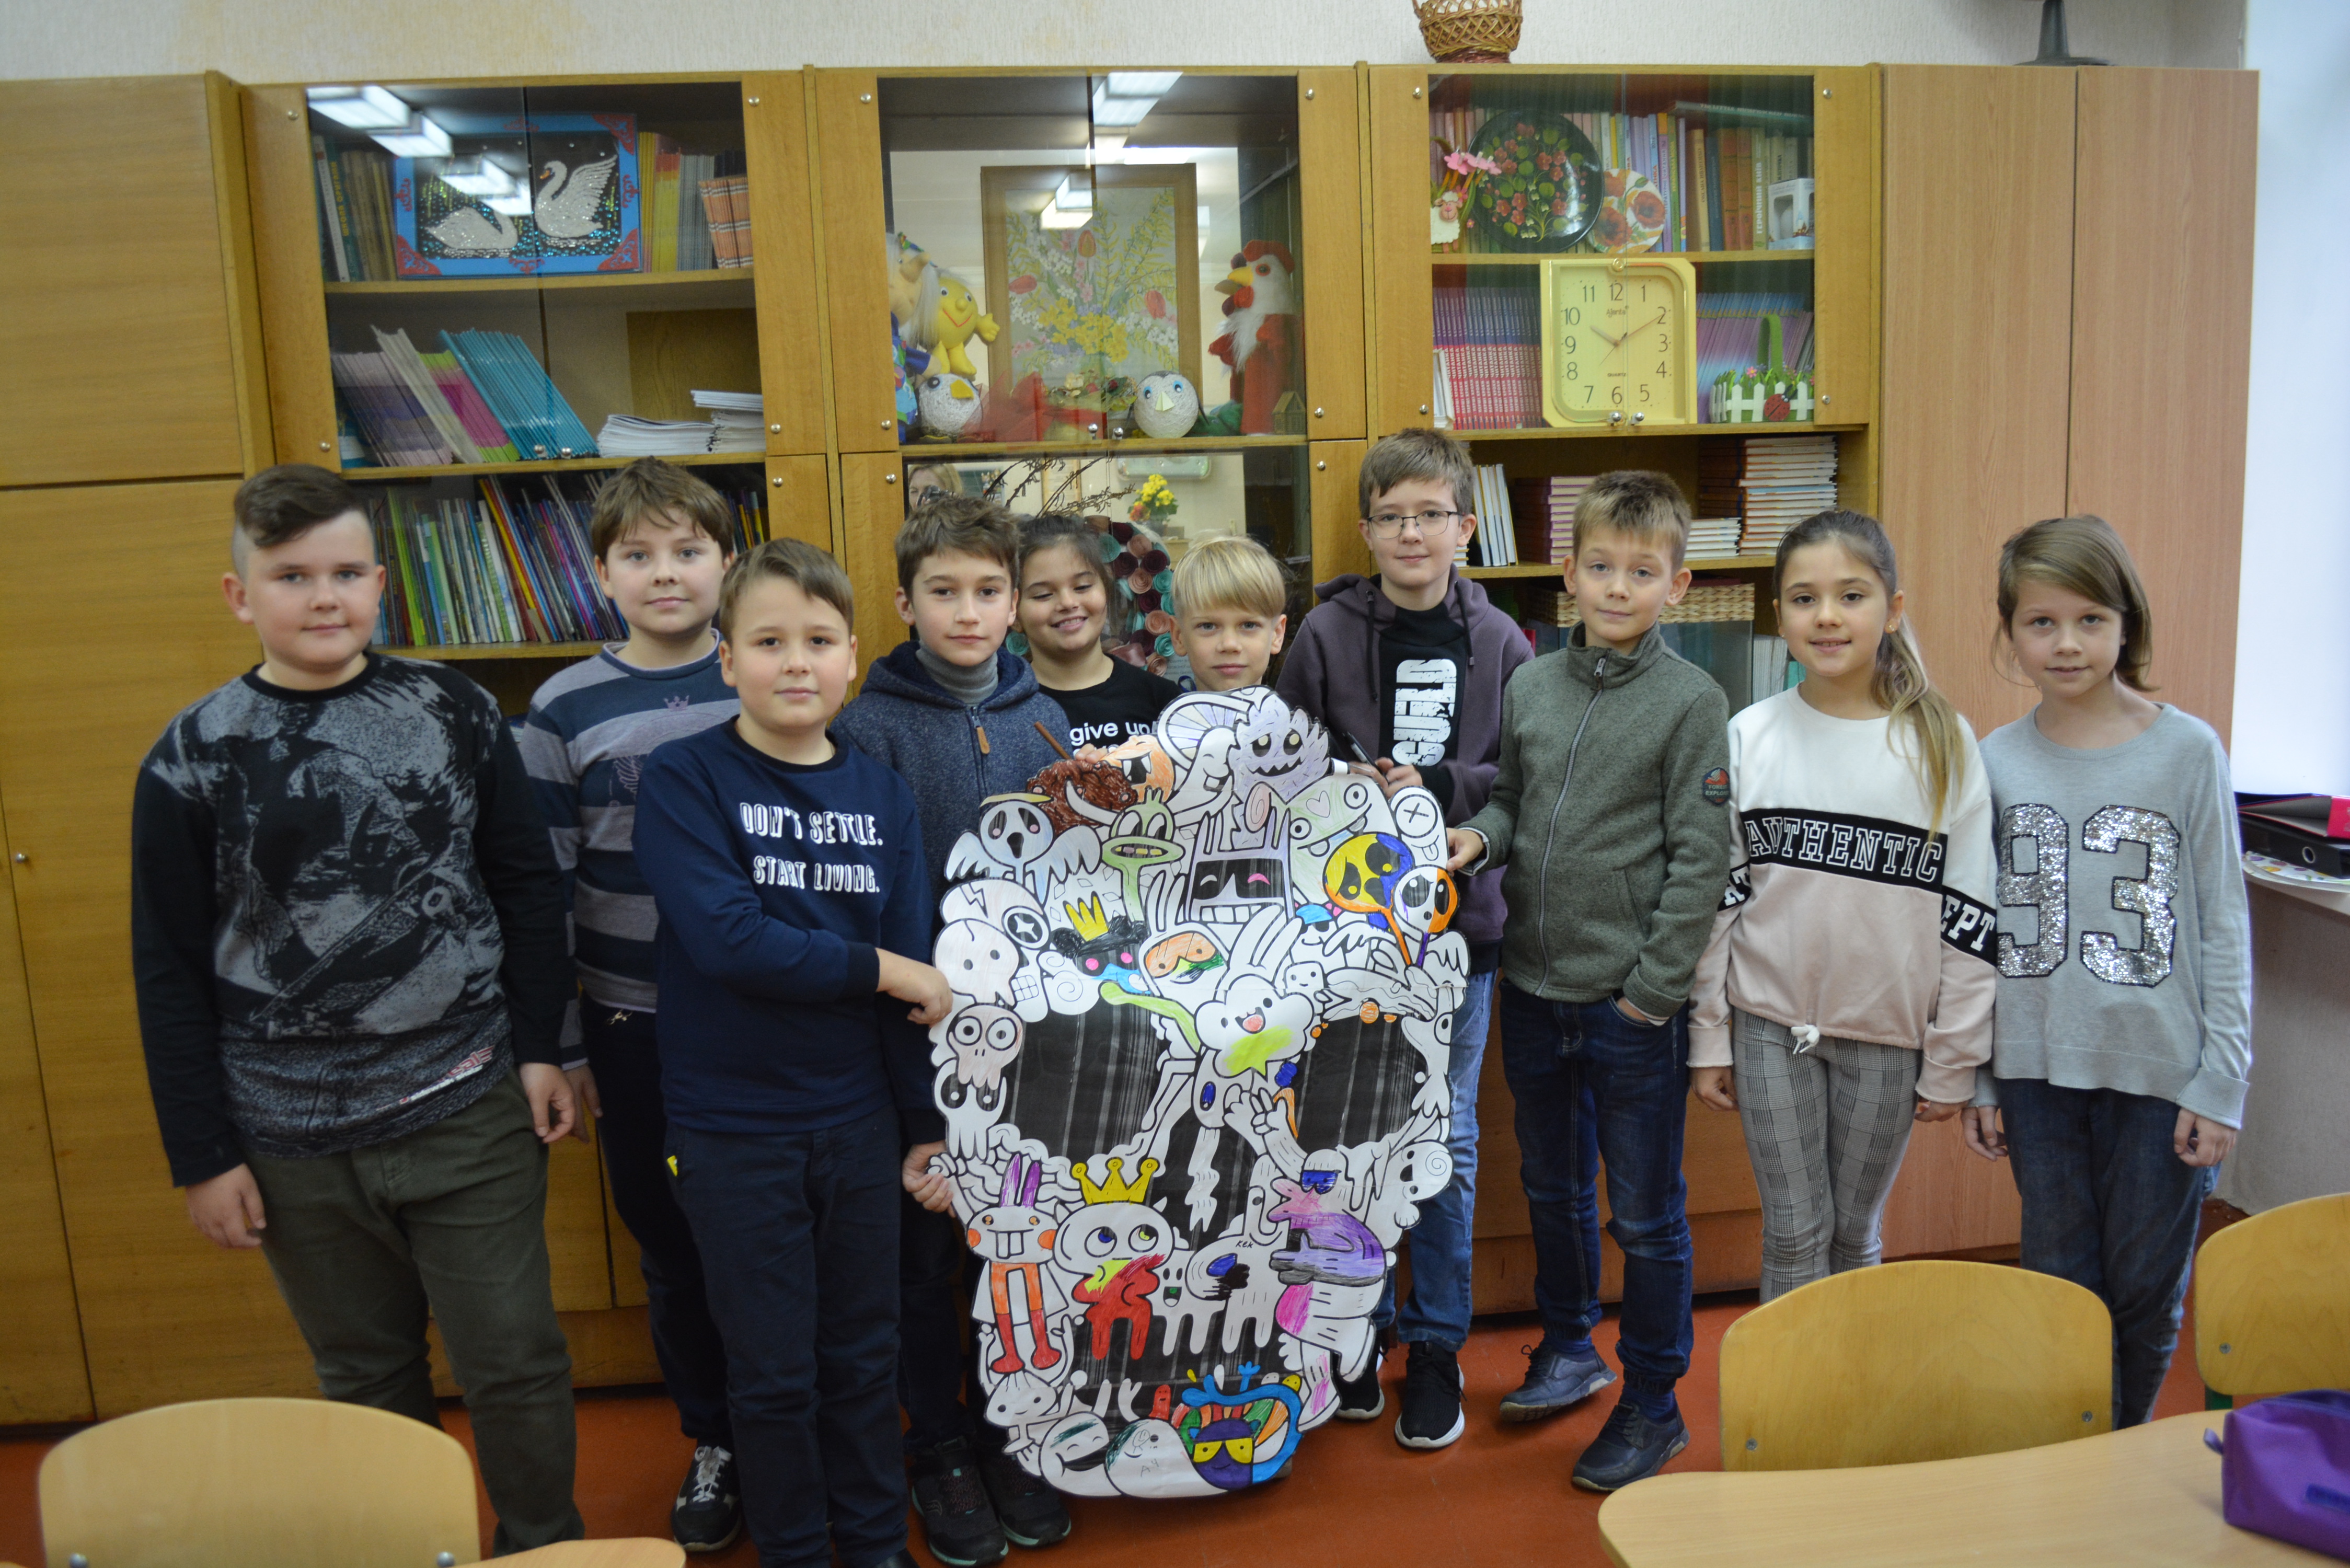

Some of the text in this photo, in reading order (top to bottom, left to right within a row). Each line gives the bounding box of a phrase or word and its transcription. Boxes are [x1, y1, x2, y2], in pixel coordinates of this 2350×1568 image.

[1583, 285, 1595, 302] 11
[1609, 283, 1623, 301] 12
[1641, 284, 1645, 302] 1
[1563, 307, 1580, 326] 10
[1657, 306, 1666, 324] 2
[1565, 336, 1576, 354] 9
[1658, 333, 1668, 352] 3
[1567, 362, 1578, 380] 8
[1656, 361, 1667, 378] 4
[1584, 385, 1594, 403] 7
[1611, 386, 1622, 404] 6
[1640, 384, 1650, 402] 5
[1069, 722, 1119, 746] give
[740, 802, 803, 839] DON'T
[1744, 815, 1943, 883] AUTHENTIC
[753, 855, 881, 893] START LIVING.
[1996, 803, 2182, 989] 93
